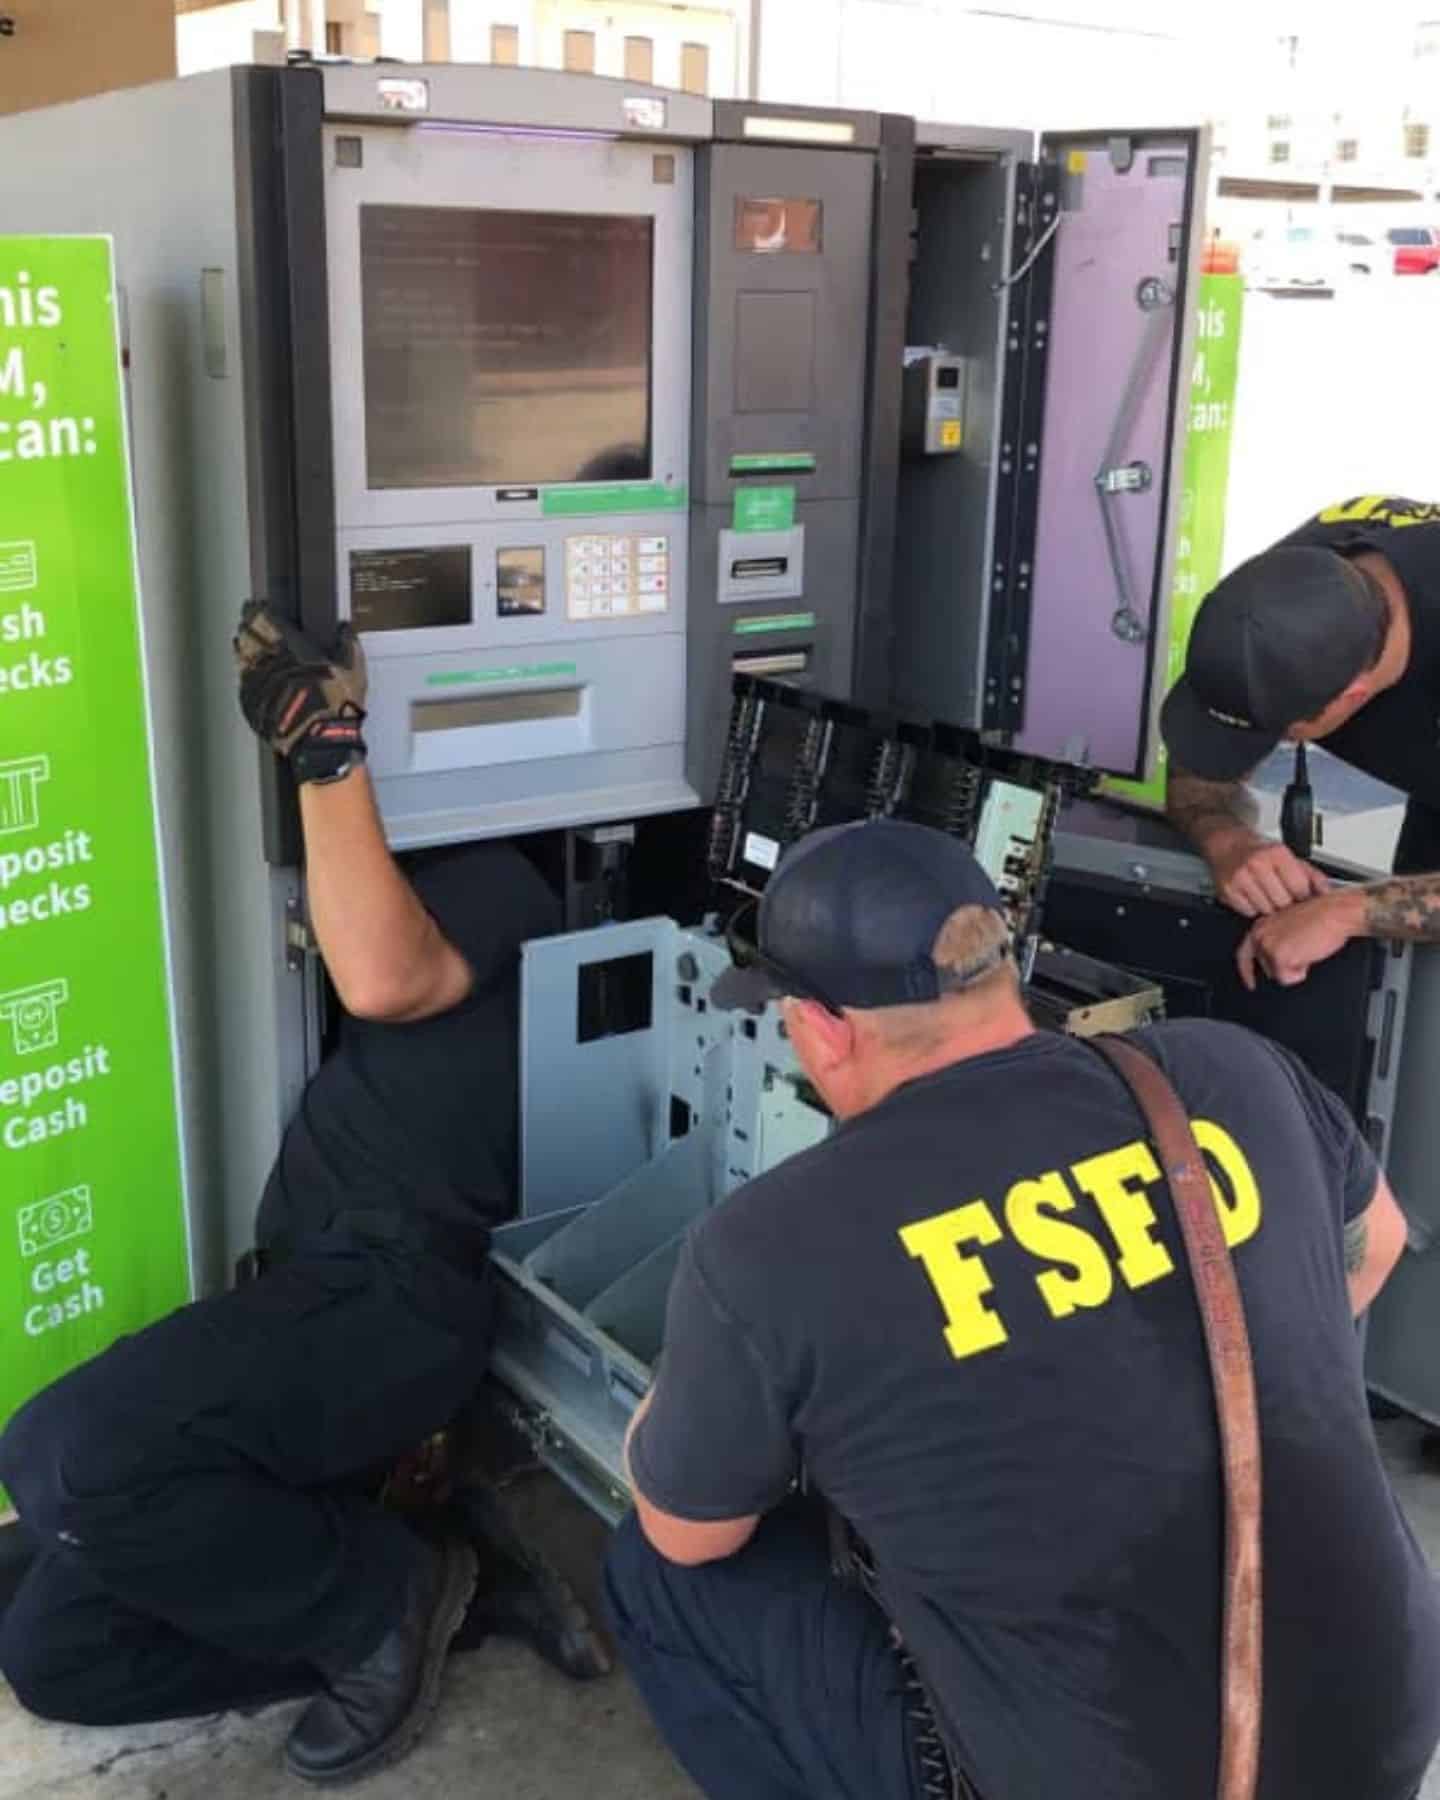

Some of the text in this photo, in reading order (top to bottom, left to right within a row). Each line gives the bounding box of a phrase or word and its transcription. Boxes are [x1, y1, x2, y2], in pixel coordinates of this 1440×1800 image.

[0, 881, 92, 930] ecks
[0, 1043, 111, 1108] eposit
[4, 1096, 88, 1149] Cash
[897, 1119, 1262, 1359] FSFD
[31, 1248, 91, 1293] Get
[24, 1281, 105, 1336] Cash
